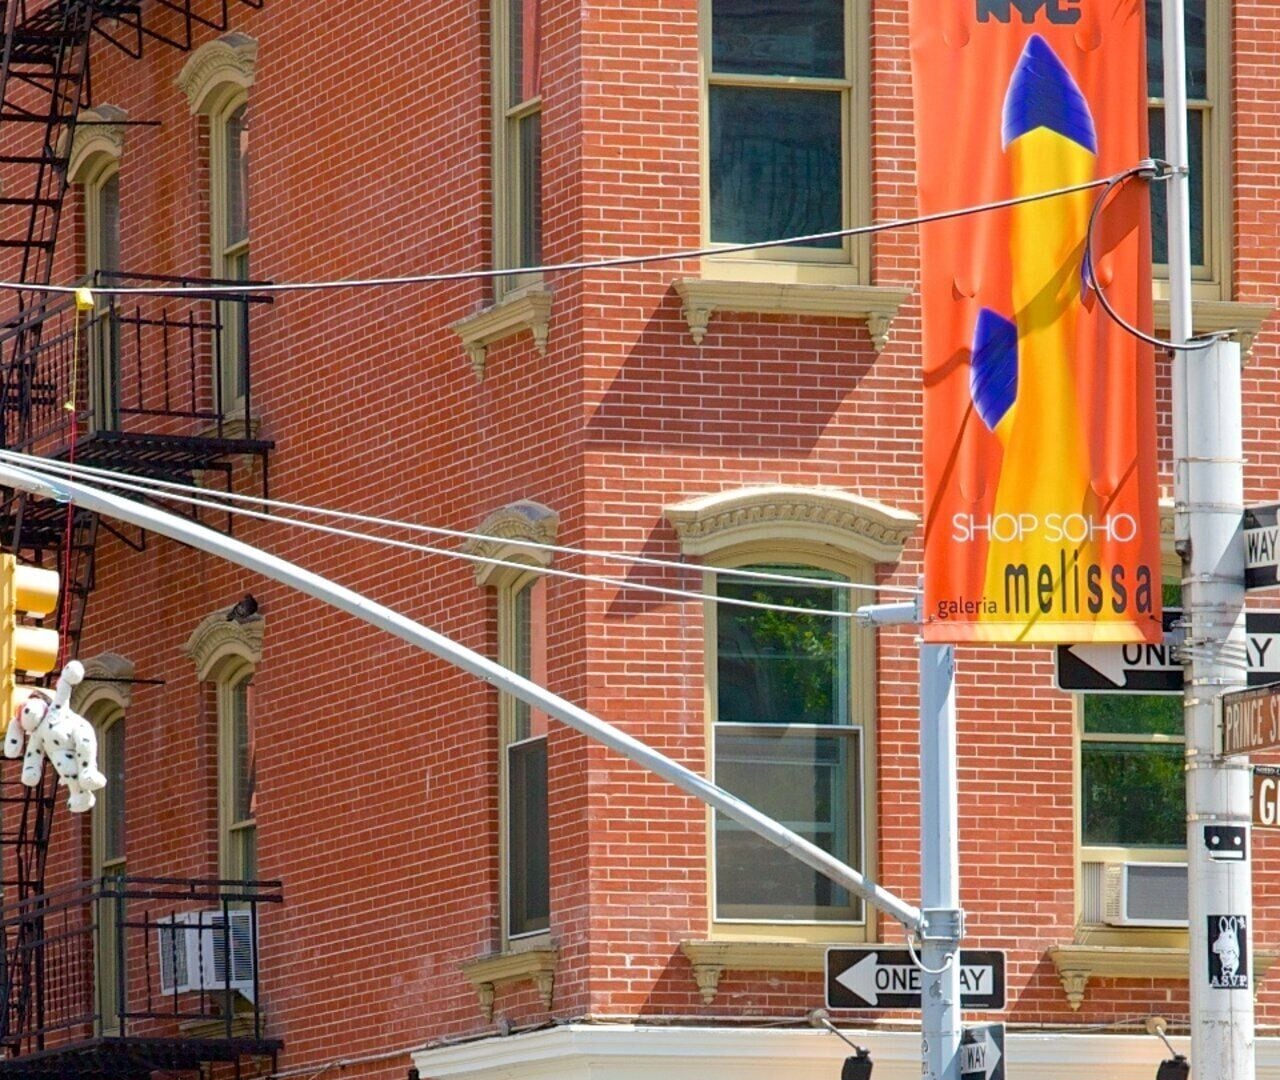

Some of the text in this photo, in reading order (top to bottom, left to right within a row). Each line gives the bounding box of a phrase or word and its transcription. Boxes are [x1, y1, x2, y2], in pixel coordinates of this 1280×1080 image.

[976, 0, 1081, 24] NYC
[951, 513, 1137, 542] SHOP SOHO
[937, 548, 1152, 619] galeria melissa
[1225, 698, 1263, 752] PRINCE
[960, 968, 986, 992] AY
